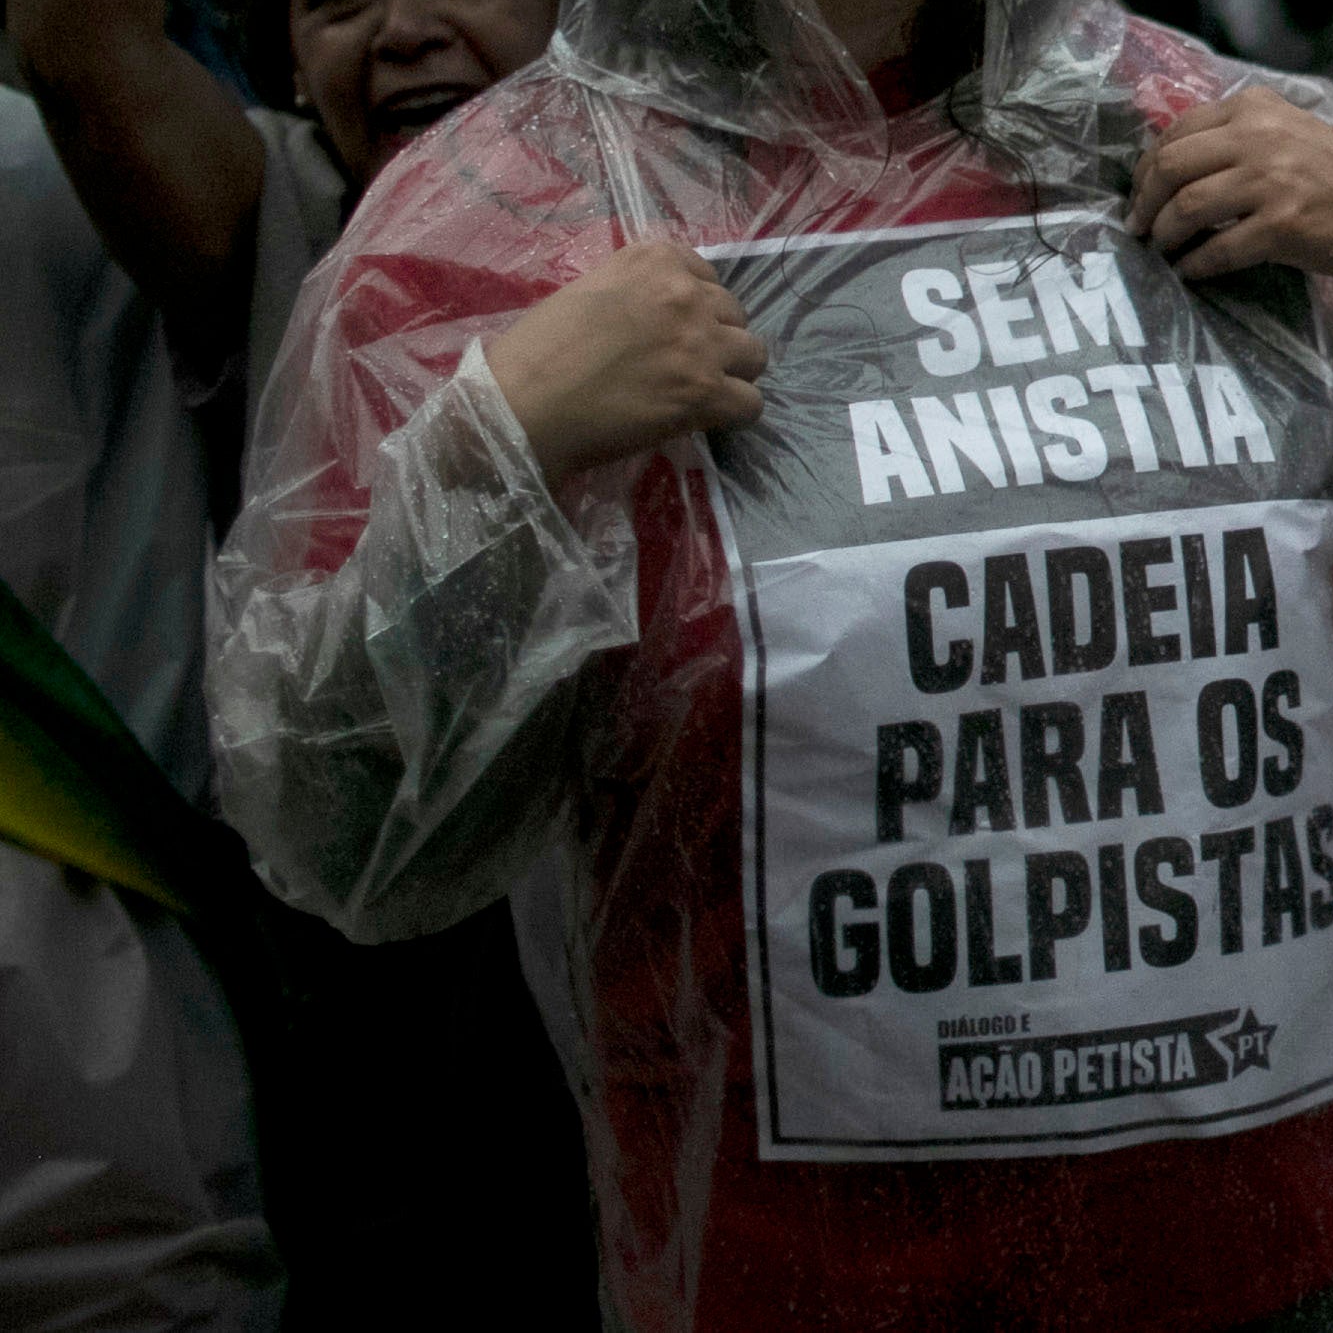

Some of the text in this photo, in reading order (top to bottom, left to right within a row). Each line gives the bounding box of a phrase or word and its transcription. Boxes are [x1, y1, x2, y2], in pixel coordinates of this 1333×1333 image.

[901, 250, 1147, 377] SEM
[848, 362, 1276, 504] ANISTIA
[904, 527, 1280, 694] CADEIA
[875, 669, 1305, 843] PARA OS
[937, 1013, 1032, 1039] DIÁLOGO E
[944, 1029, 1269, 1109] AÇÃO PETISTA PT
